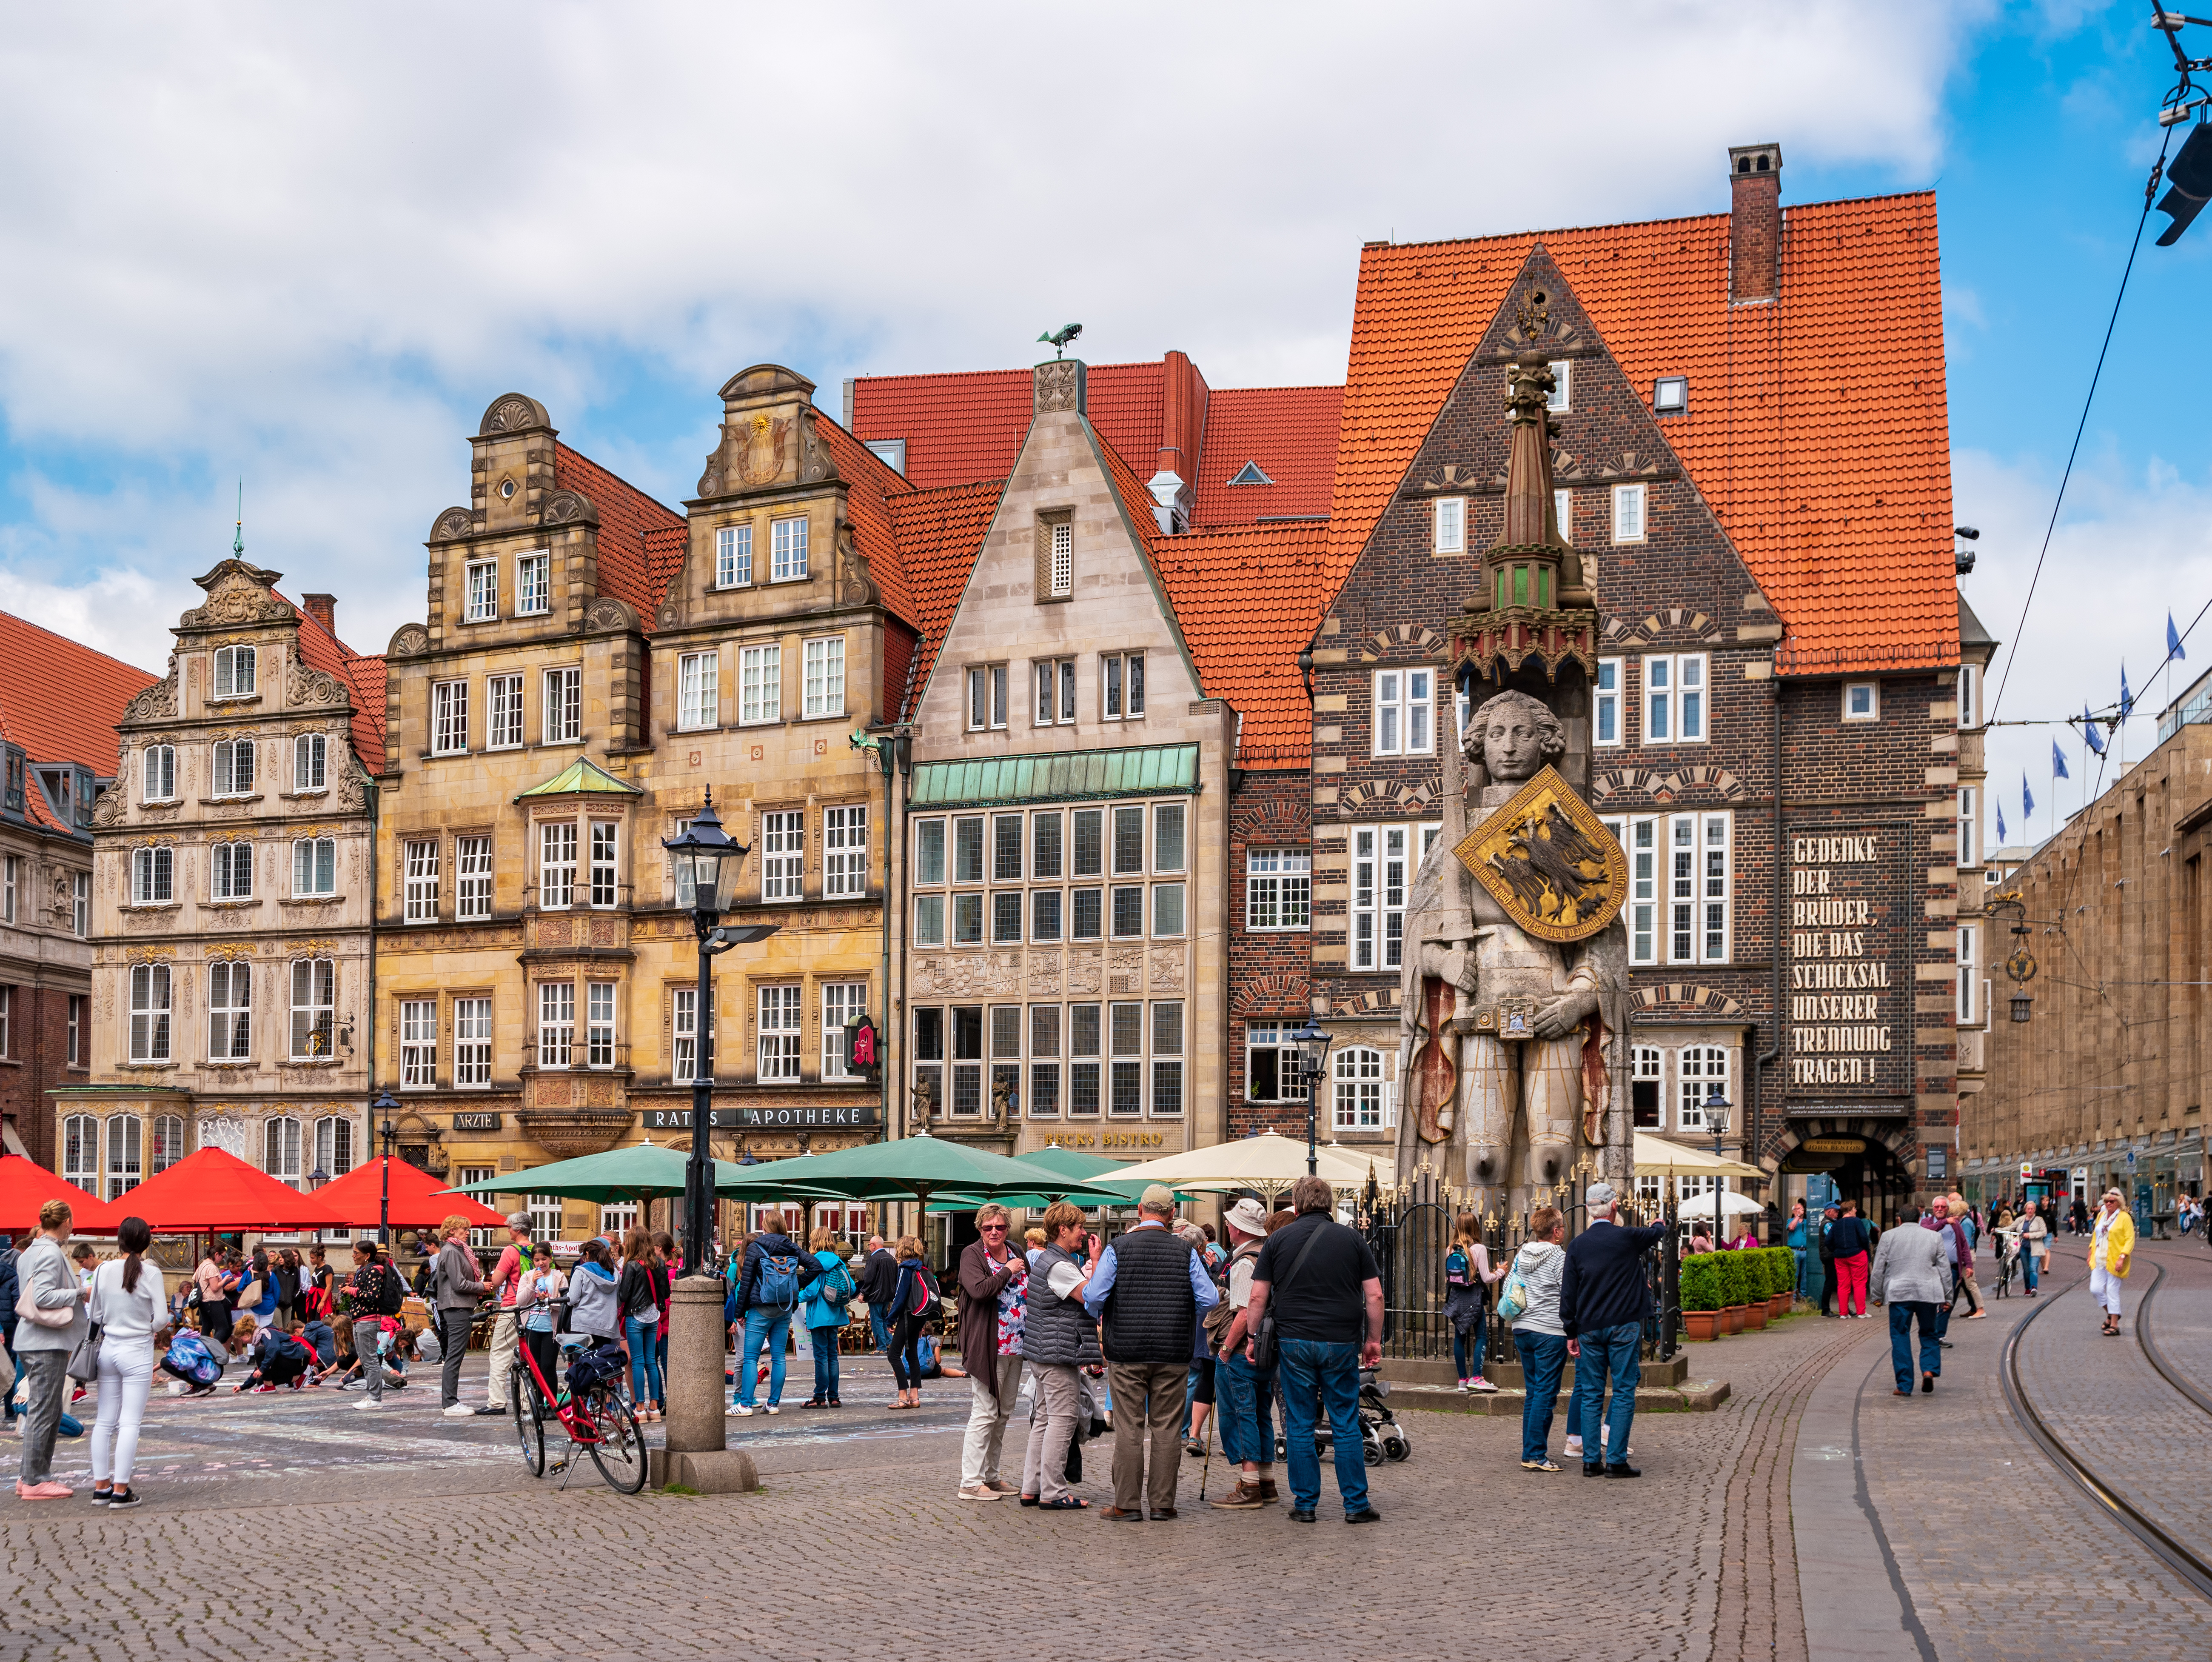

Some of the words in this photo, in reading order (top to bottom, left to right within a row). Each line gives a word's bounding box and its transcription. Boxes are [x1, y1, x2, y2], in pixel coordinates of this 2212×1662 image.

[1794, 836, 1877, 863] GEDENKE
[1794, 869, 1829, 895] DER
[1794, 932, 1823, 958] DIE
[1830, 931, 1863, 957] DAS
[1793, 962, 1890, 990] SCHICKSAL
[1793, 995, 1878, 1021] UNSERER
[1793, 1026, 1891, 1052] TRENNUNG
[81, 1074, 115, 1082] Sparkasse
[457, 1114, 492, 1127] ÄRZTE
[656, 1111, 717, 1125] RATS
[751, 1109, 860, 1125] APOTHEKE
[1102, 1133, 1162, 1145] BISTRO
